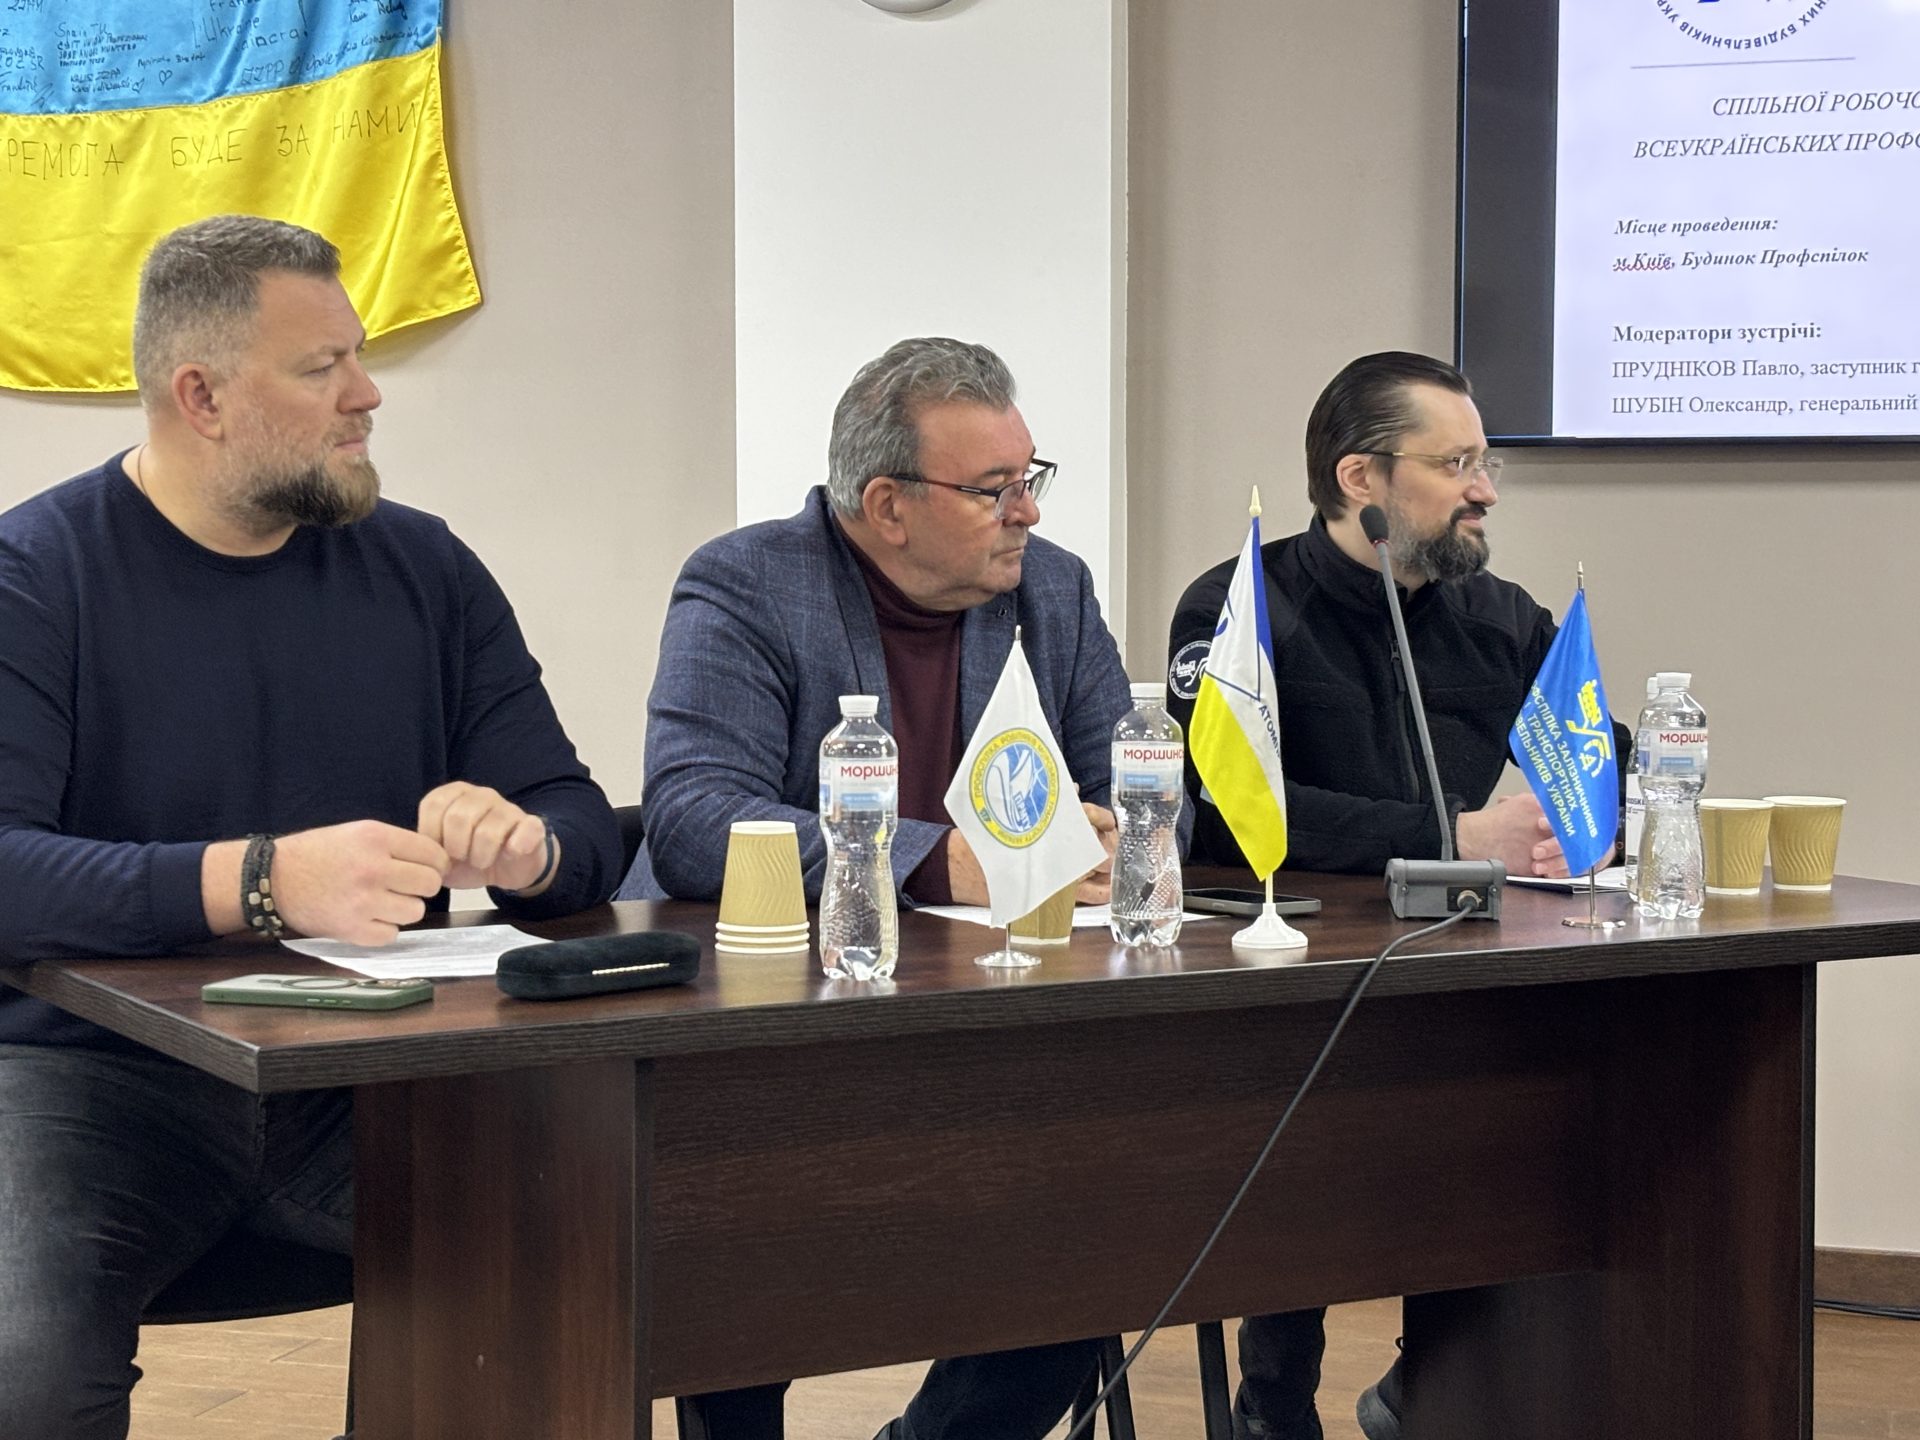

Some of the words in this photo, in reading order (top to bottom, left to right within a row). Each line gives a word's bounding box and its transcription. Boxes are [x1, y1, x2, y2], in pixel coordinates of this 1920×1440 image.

[1679, 21, 1797, 50] БУДІВЕЛЬНИКІВ
[1712, 91, 1828, 117] СПІЛЬНОЇ
[2, 137, 125, 181] РЕМОГА
[170, 128, 247, 169] БУДЕ
[276, 124, 311, 157] ЗА
[332, 102, 417, 144] НАМИ
[1633, 133, 1844, 159] ВСЕУКРАЇНСЬКИХ
[1613, 218, 1667, 238] Місце
[1671, 217, 1779, 237] проведення:
[1681, 250, 1757, 271] Будинок
[1760, 247, 1869, 269] Профспілок
[1612, 325, 1732, 345] Модератори
[1737, 322, 1822, 344] зустрічі:
[1612, 360, 1737, 382] ПРУДНІКОВ
[1742, 359, 1805, 378] Павло,
[1810, 362, 1907, 379] заступник
[1612, 396, 1684, 414] ШУБІН
[1689, 396, 1794, 416] Олександр,
[1799, 393, 1918, 415] генеральний
[1515, 710, 1553, 784] ВЕЛЬНИКІВ
[1547, 785, 1577, 838] УКРАЇНИ
[1527, 712, 1580, 812] ТРАНСПОРТНИХ
[1557, 741, 1598, 838] ЗАЛІЗНИЧНИКІВ
